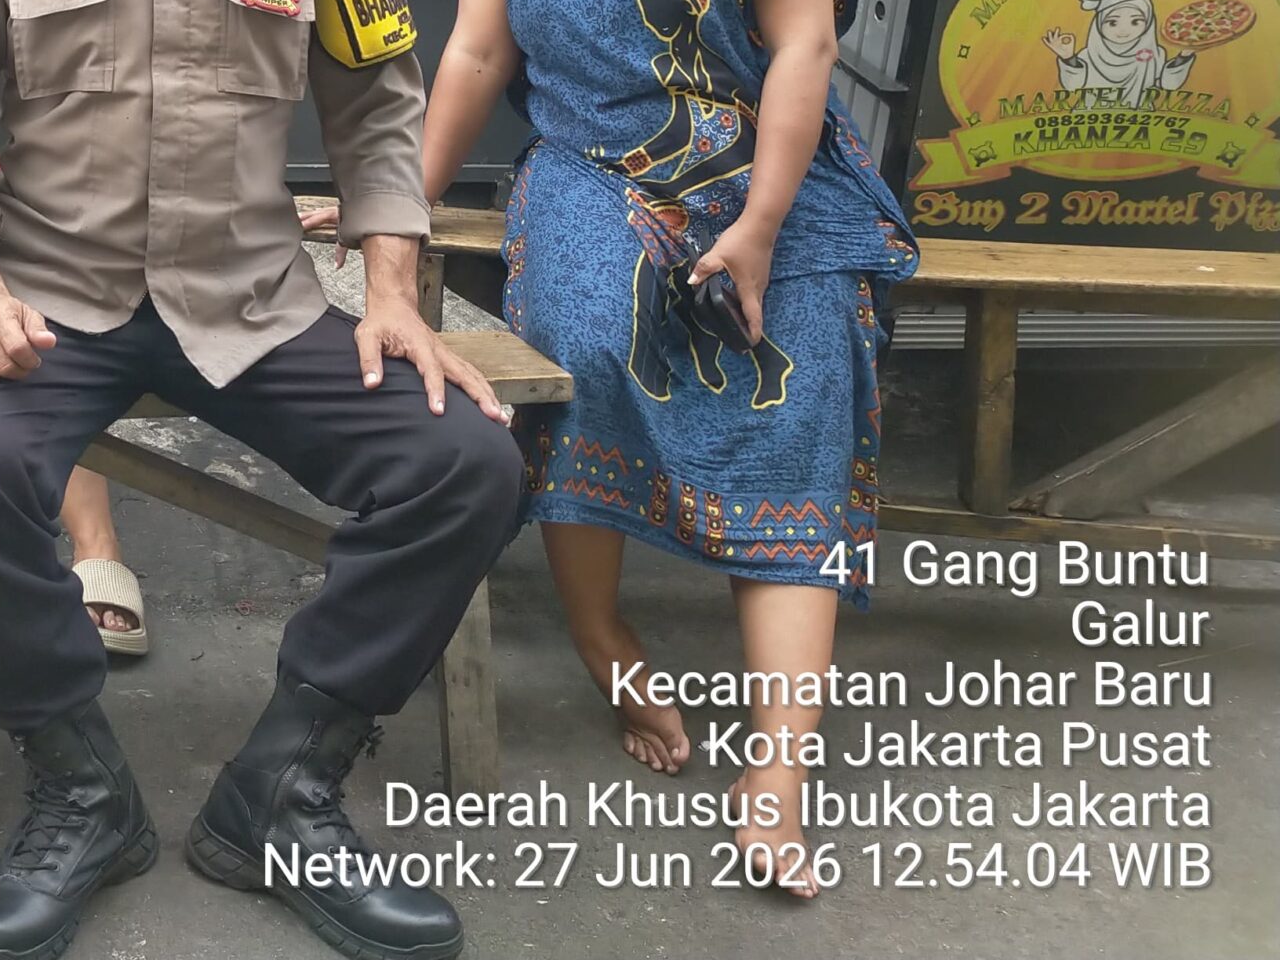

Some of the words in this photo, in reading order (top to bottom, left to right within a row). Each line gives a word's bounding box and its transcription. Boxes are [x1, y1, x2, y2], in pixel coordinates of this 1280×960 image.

[998, 86, 1133, 119] MARTEL
[1141, 88, 1232, 119] PIZZA
[1034, 113, 1191, 129] 088293642767
[1013, 125, 1152, 156] KHANZA
[1160, 128, 1208, 156] 29
[913, 191, 1007, 232] Buy
[1015, 192, 1051, 225] 2
[1061, 190, 1205, 226] Martel
